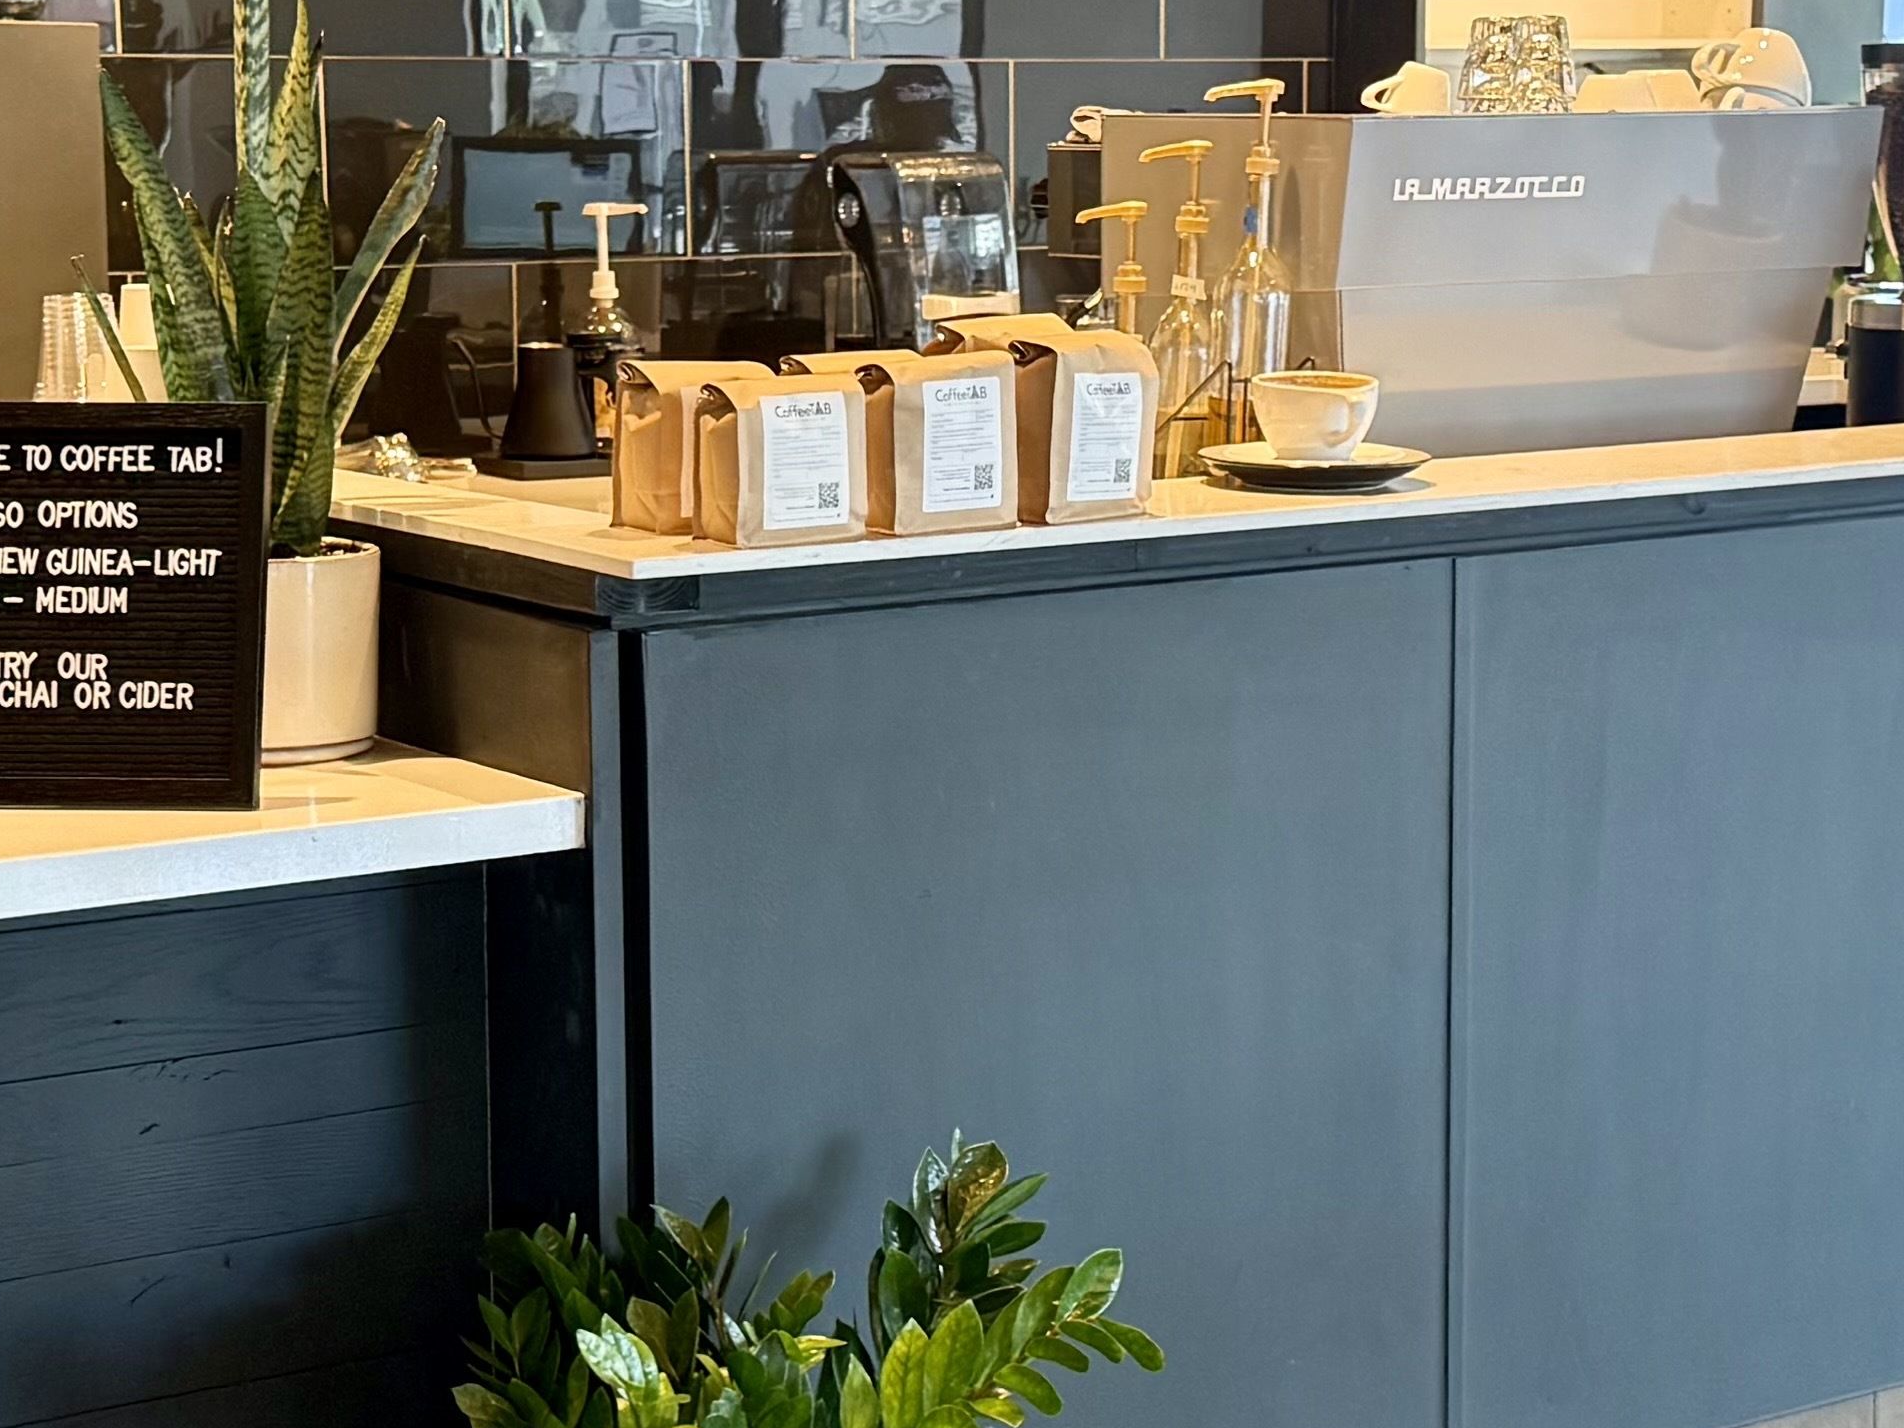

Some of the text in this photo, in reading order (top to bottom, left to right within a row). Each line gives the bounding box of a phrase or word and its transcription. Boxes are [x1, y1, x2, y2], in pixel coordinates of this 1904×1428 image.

[1393, 178, 1419, 201] LA
[20, 444, 54, 473] TO
[58, 443, 157, 474] COFFEE
[166, 437, 223, 473] TAB!
[35, 498, 140, 531] OPTIONS
[33, 584, 130, 616] MEDIUM
[56, 651, 110, 683] OUR
[71, 681, 113, 711] OR
[117, 681, 196, 712] CIDER
